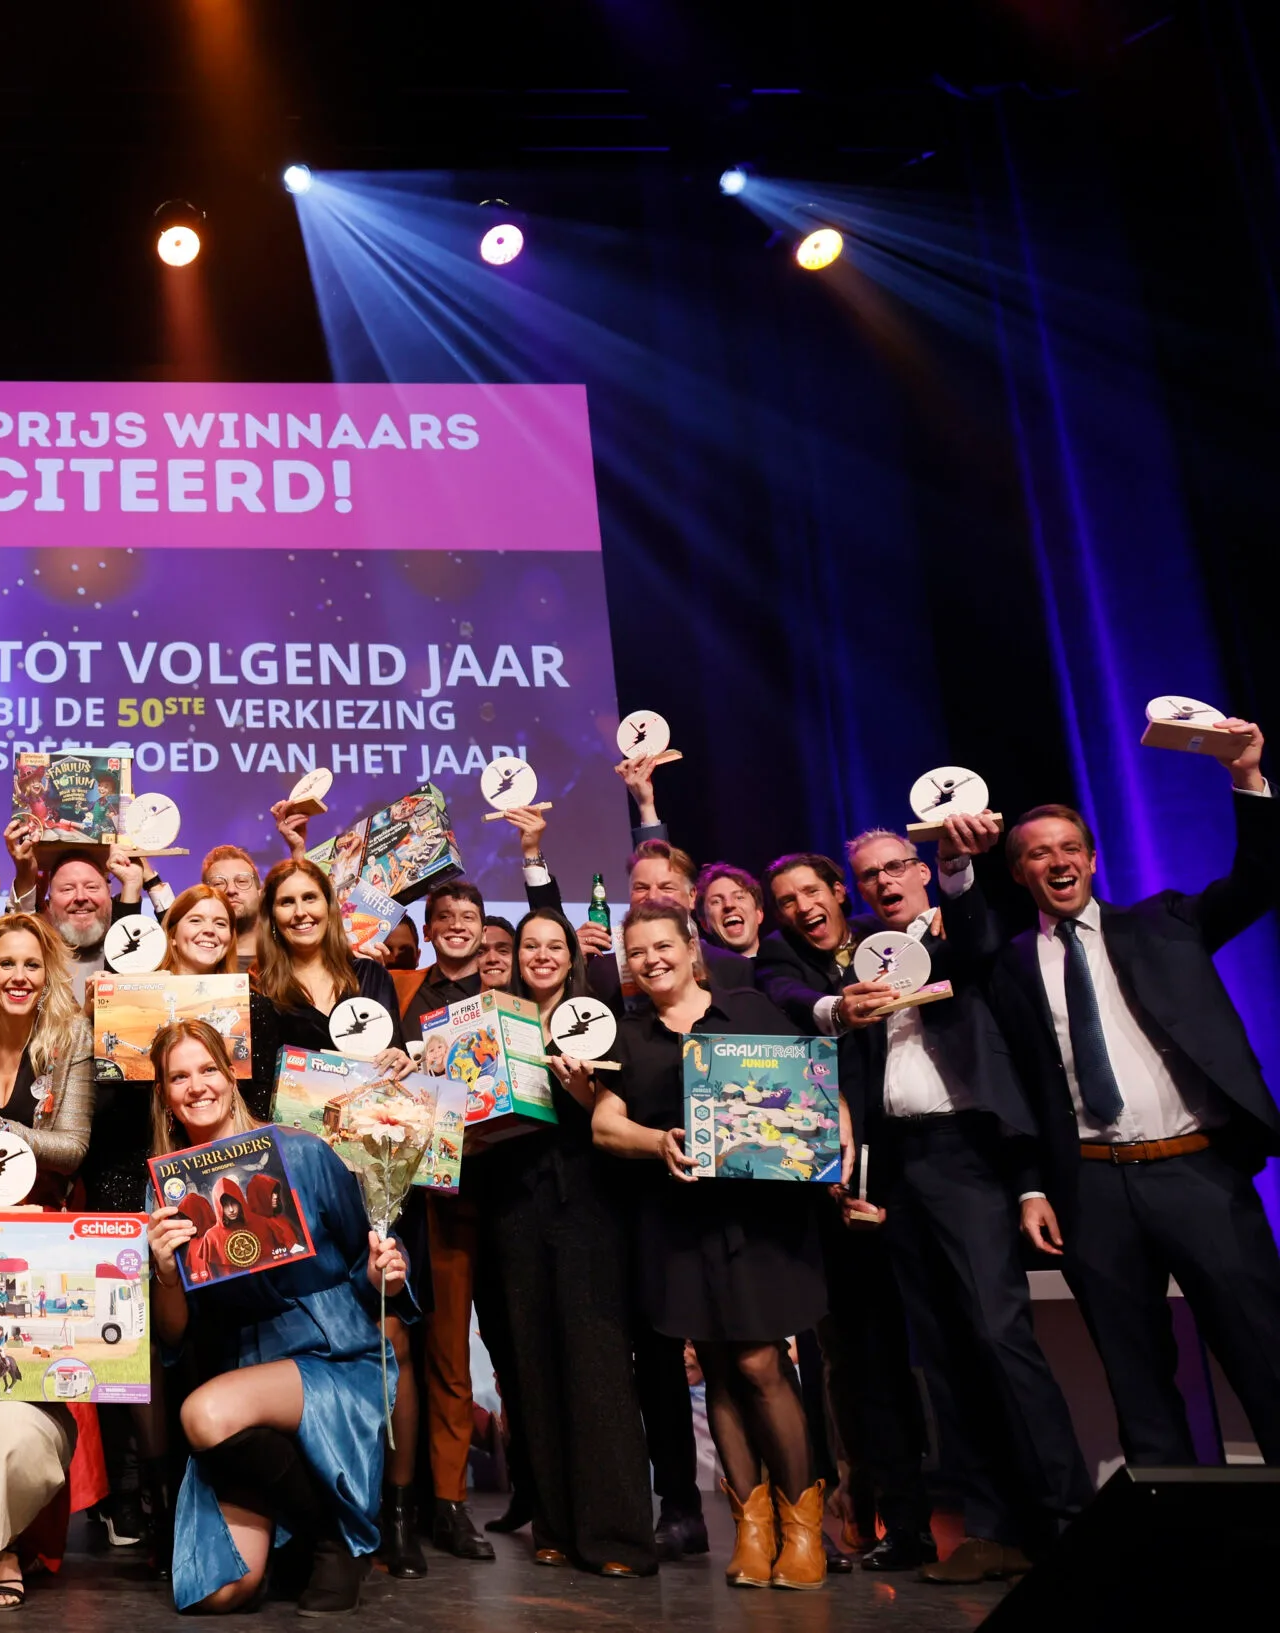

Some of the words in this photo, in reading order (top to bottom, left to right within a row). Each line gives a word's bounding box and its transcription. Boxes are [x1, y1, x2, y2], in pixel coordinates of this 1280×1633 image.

[163, 413, 479, 450] WINNAARS
[118, 641, 406, 686] VOLGEND
[421, 644, 570, 697] JAAR
[55, 697, 105, 727] DE
[117, 697, 205, 728] 50STE
[215, 699, 455, 730] VERKIEZING
[230, 743, 318, 773] VAN
[332, 744, 407, 774] HET
[453, 1009, 481, 1026] GLOBE
[460, 1002, 479, 1015] FIRST
[714, 1044, 806, 1058] GRAVITRAX
[311, 1058, 349, 1076] Friends
[741, 1058, 779, 1069] JUNIOR
[160, 1162, 181, 1178] DE
[182, 1136, 272, 1171] VERRADERS
[81, 1221, 134, 1236] schleich
